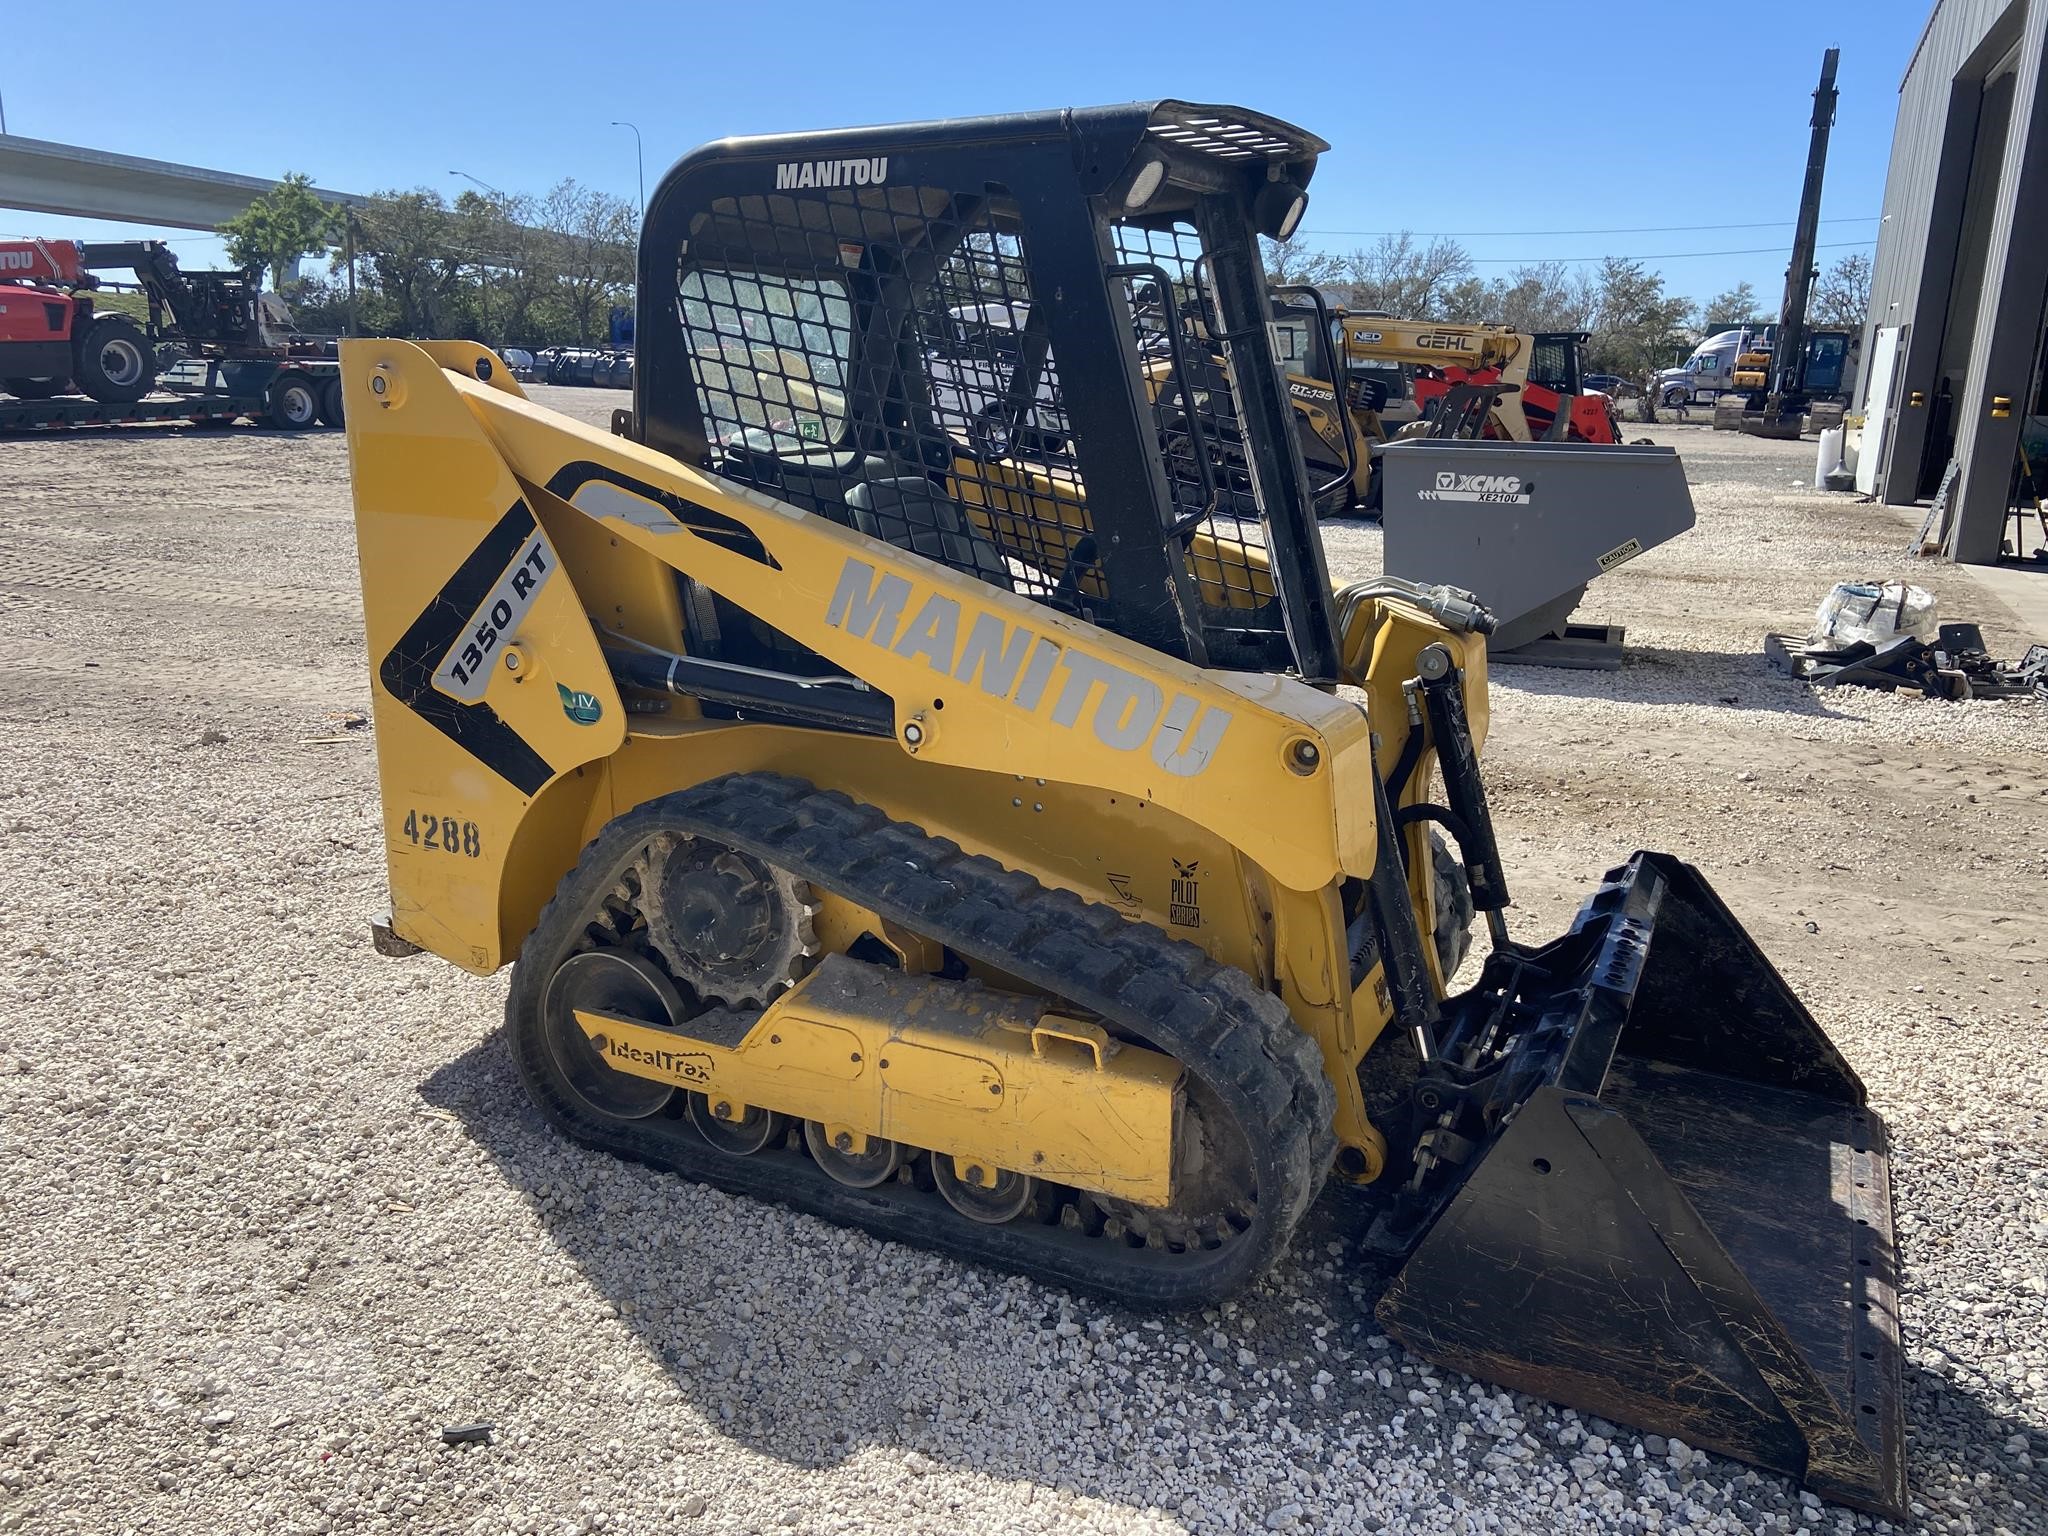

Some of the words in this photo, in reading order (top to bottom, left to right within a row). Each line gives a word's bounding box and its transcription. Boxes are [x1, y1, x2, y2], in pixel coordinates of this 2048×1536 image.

[776, 157, 888, 190] MANITOU
[1353, 331, 1383, 341] NED
[1416, 334, 1474, 352] GEHL
[1454, 474, 1521, 493] XCMG
[1478, 493, 1519, 503] XE210U
[1603, 542, 1636, 564] CAUTION
[451, 598, 512, 686] 1350
[511, 542, 547, 601] RT
[824, 556, 1233, 777] MANITOU
[404, 809, 480, 858] 4288
[1171, 879, 1199, 906] PILOT
[610, 1039, 711, 1081] IdealTrax
